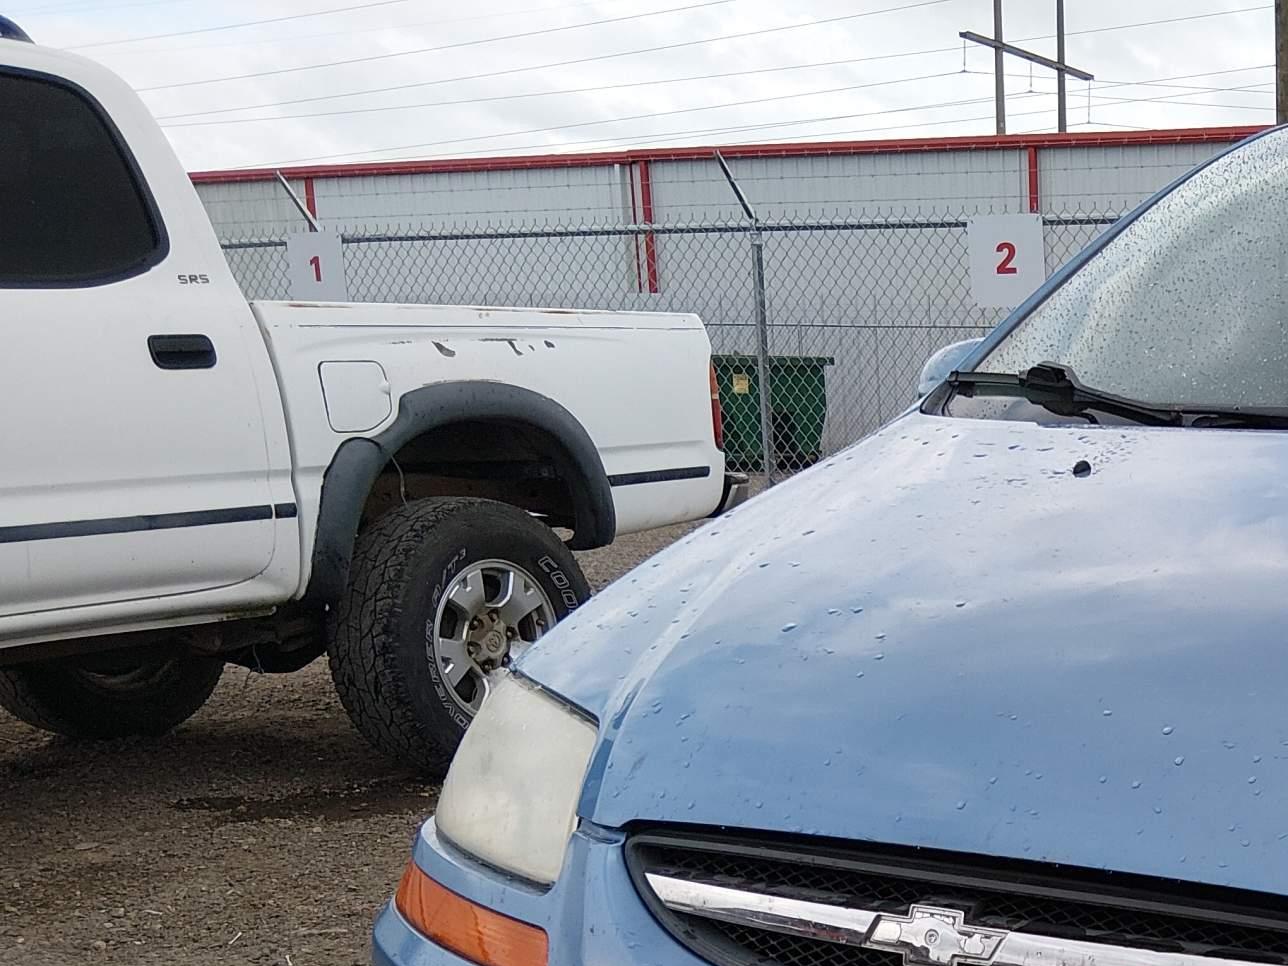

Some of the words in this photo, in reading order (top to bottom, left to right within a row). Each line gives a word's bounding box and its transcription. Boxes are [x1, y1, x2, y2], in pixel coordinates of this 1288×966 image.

[309, 255, 322, 282] 1
[996, 242, 1017, 274] 2
[538, 556, 579, 614] COO
